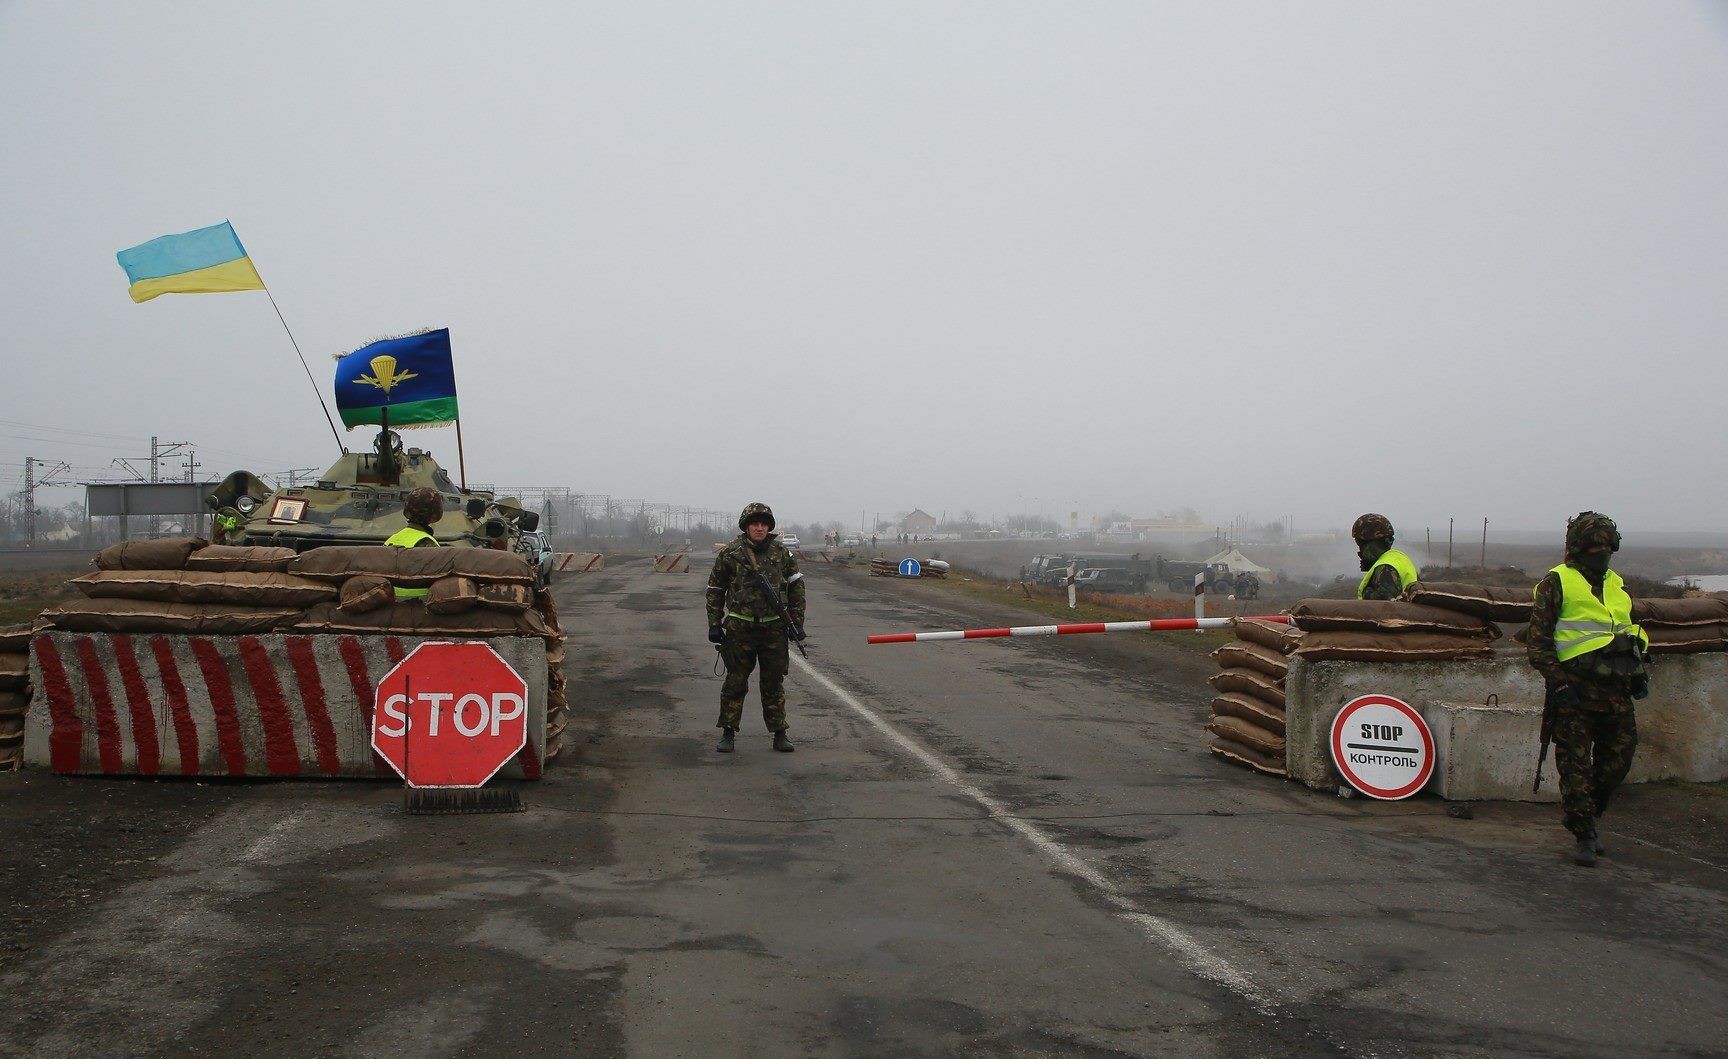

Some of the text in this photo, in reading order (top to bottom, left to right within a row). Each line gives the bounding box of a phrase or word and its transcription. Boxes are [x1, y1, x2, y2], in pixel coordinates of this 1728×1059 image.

[378, 693, 524, 737] STOP
[1361, 723, 1403, 741] STOP
[1350, 753, 1418, 768] КОНТРОЛЬ
